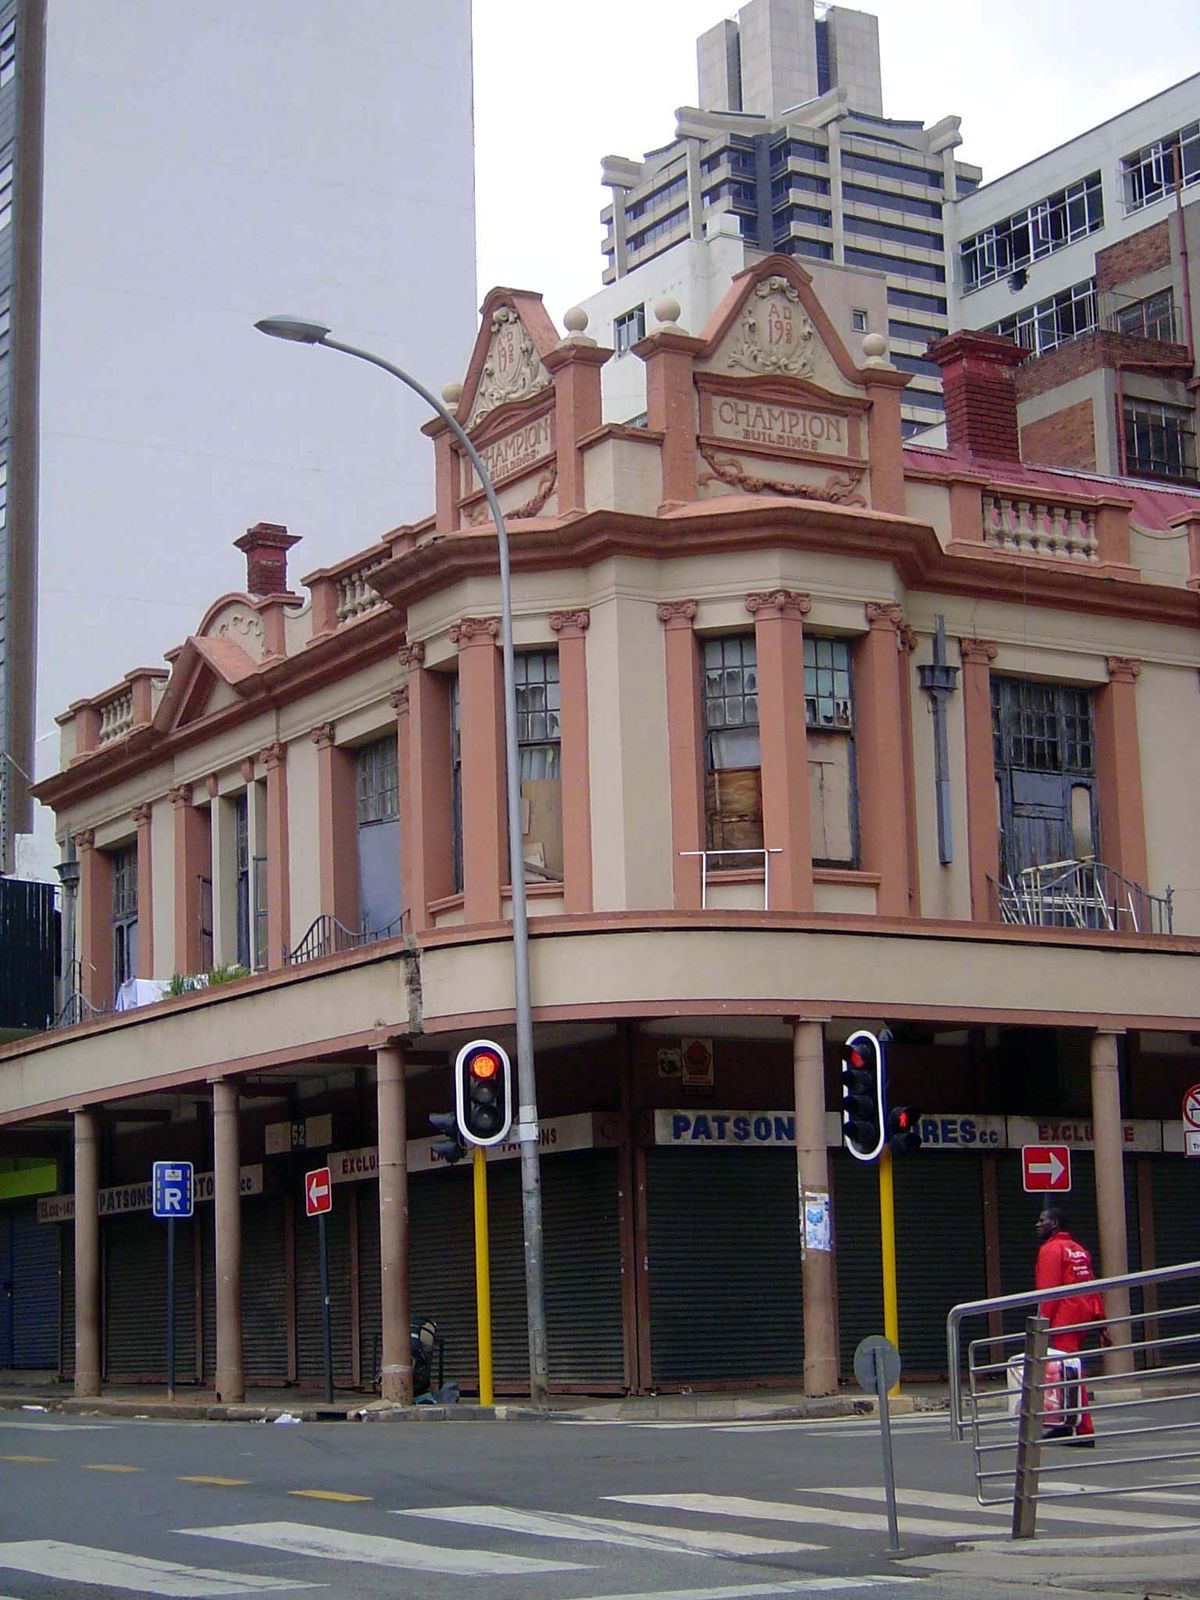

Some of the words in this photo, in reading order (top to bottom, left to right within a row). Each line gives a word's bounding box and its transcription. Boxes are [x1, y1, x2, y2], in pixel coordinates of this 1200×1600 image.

[718, 400, 841, 442] CHAMPION
[291, 1123, 305, 1146] 52
[672, 1113, 795, 1141] PATSON
[914, 1118, 976, 1143] RES
[1038, 1123, 1134, 1142] EXCLUE
[342, 1152, 380, 1174] EXCLU
[164, 1187, 182, 1211] R
